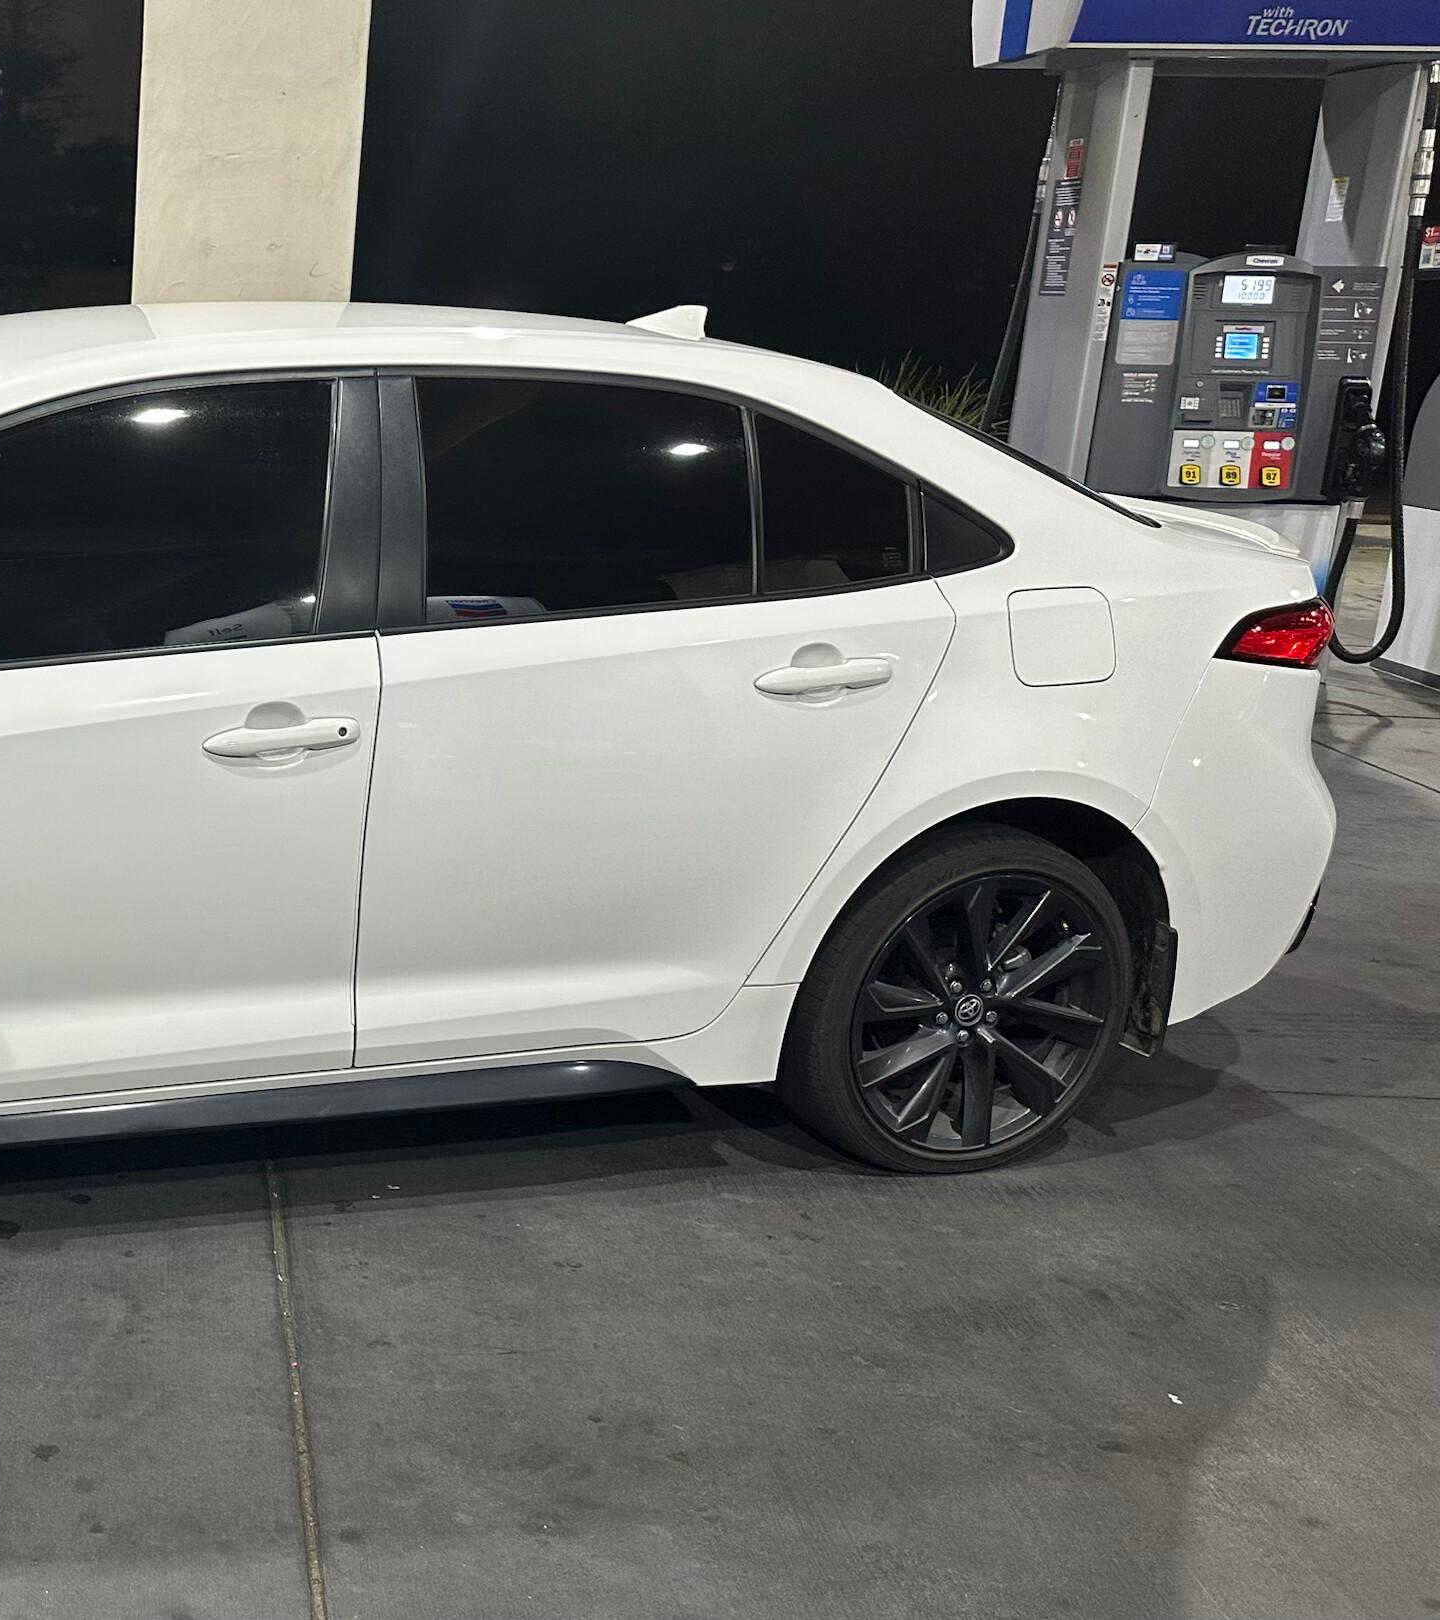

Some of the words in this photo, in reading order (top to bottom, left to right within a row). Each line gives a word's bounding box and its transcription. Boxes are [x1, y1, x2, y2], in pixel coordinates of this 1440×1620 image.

[1262, 6, 1294, 18] with
[1246, 15, 1349, 41] TECHRON
[1185, 470, 1197, 479] 91
[1225, 471, 1237, 480] 89
[1265, 472, 1277, 481] 87
